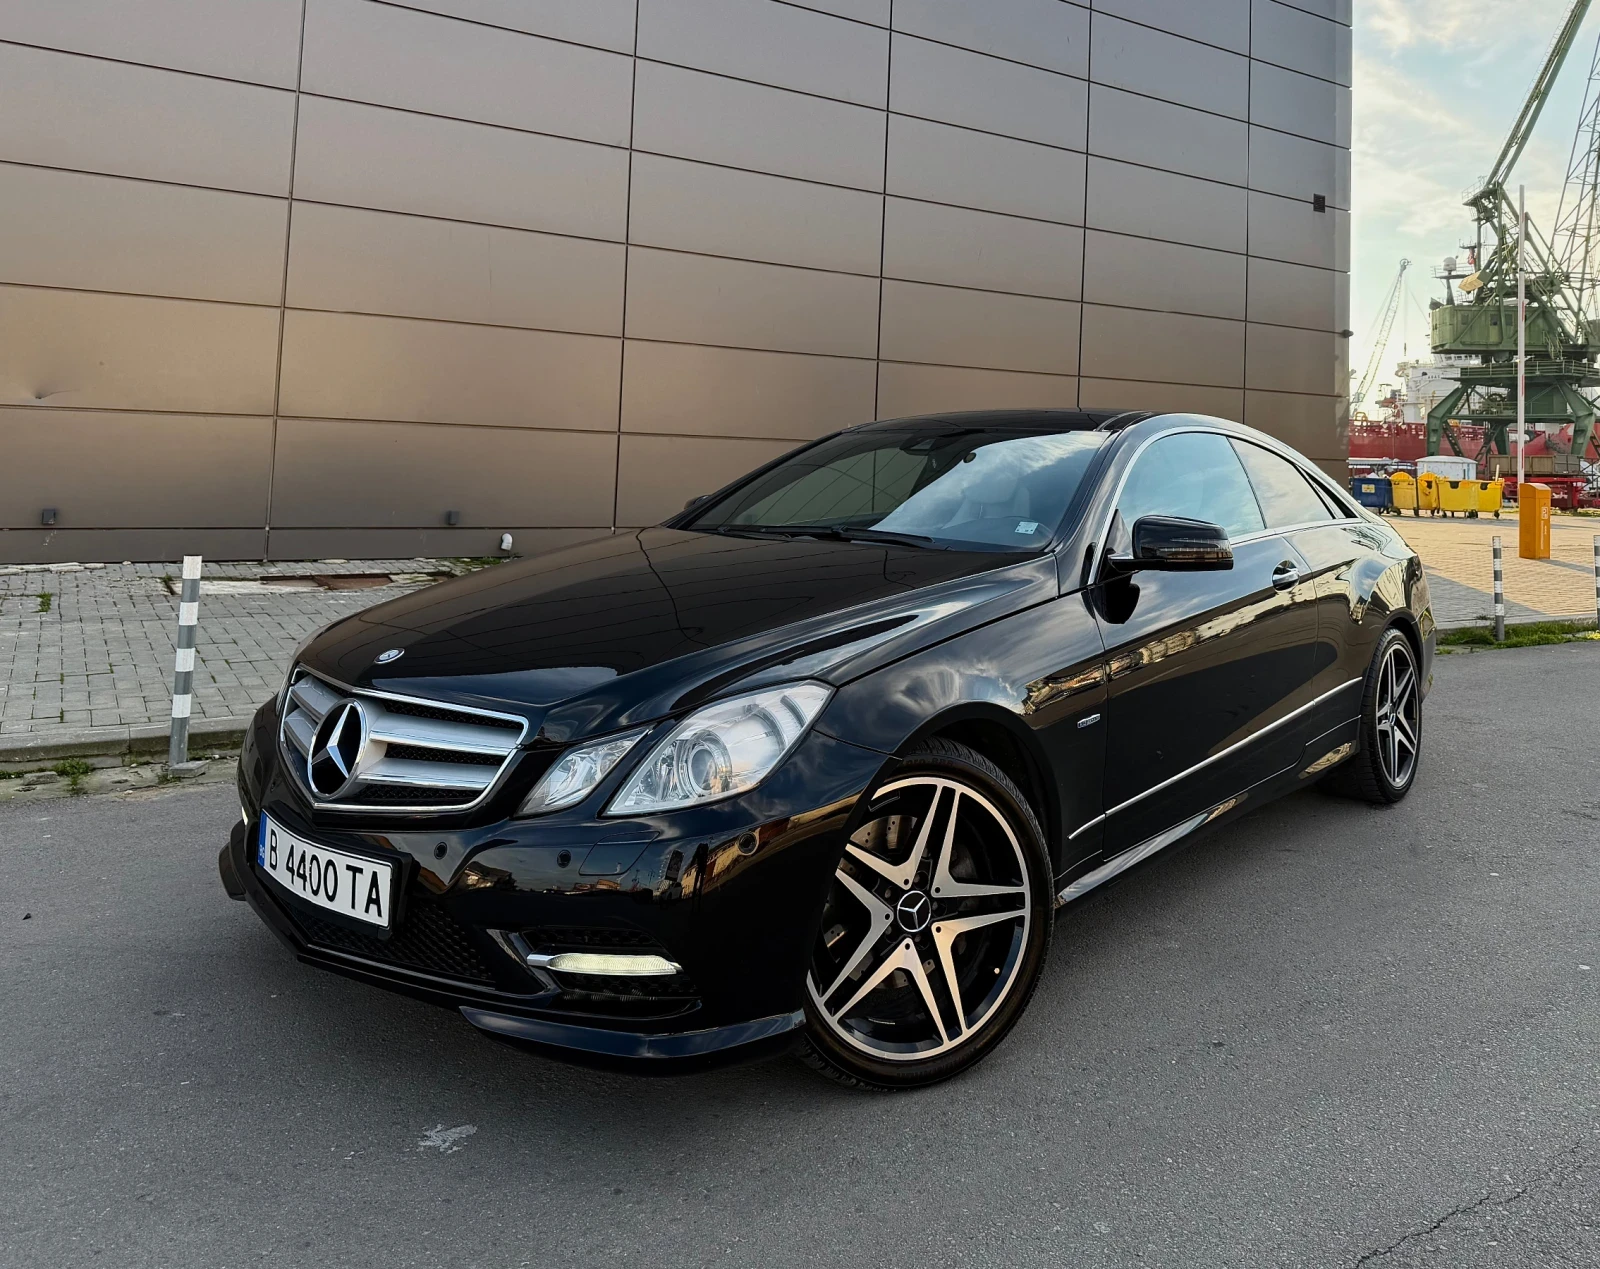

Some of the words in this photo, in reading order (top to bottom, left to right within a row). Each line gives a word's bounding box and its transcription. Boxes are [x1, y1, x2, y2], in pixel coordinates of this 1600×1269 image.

[269, 829, 278, 870] B
[285, 844, 339, 902] 4400
[345, 863, 383, 918] TA
